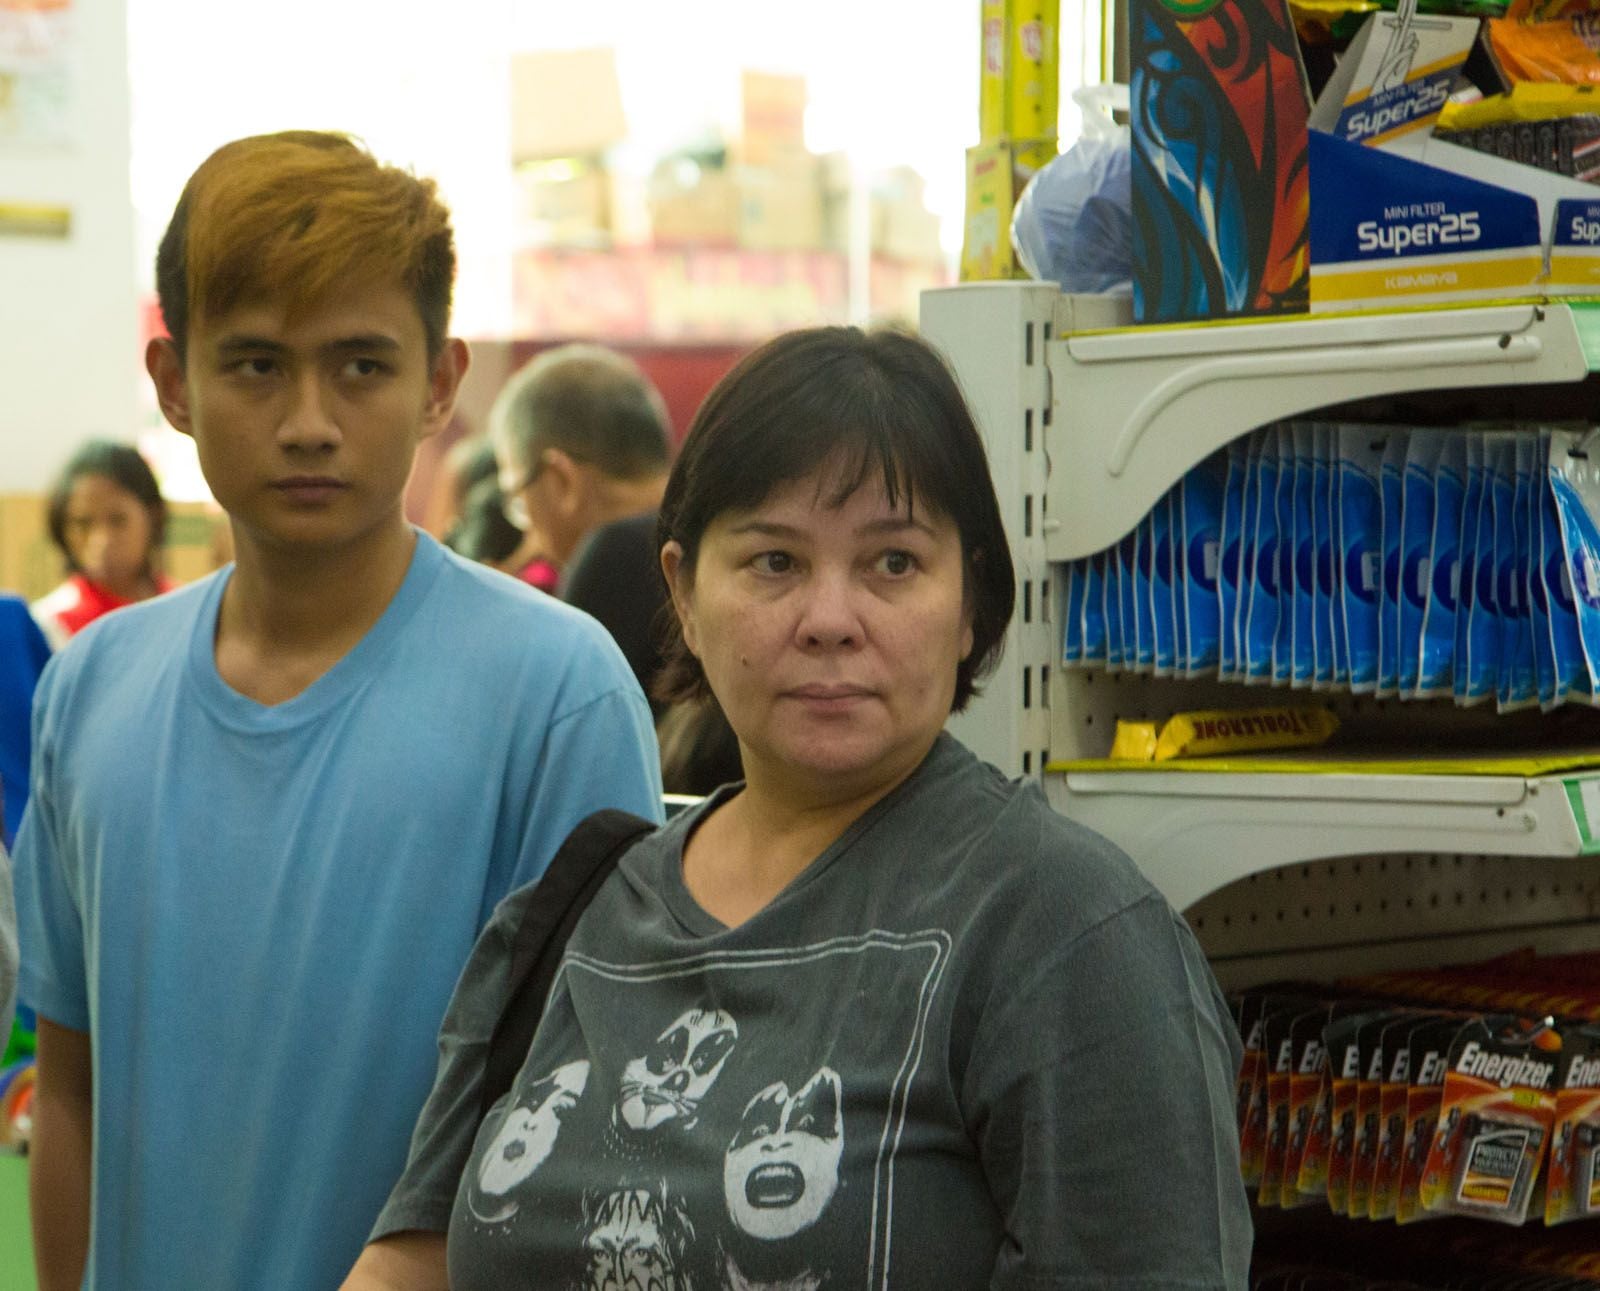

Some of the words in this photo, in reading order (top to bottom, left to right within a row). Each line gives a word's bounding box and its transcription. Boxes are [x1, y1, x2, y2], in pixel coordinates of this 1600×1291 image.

[1346, 79, 1450, 141] Super25
[1384, 206, 1408, 219] MINI
[1410, 202, 1446, 217] FILTER
[1357, 212, 1481, 254] Super25
[1456, 1041, 1553, 1088] Energizer
